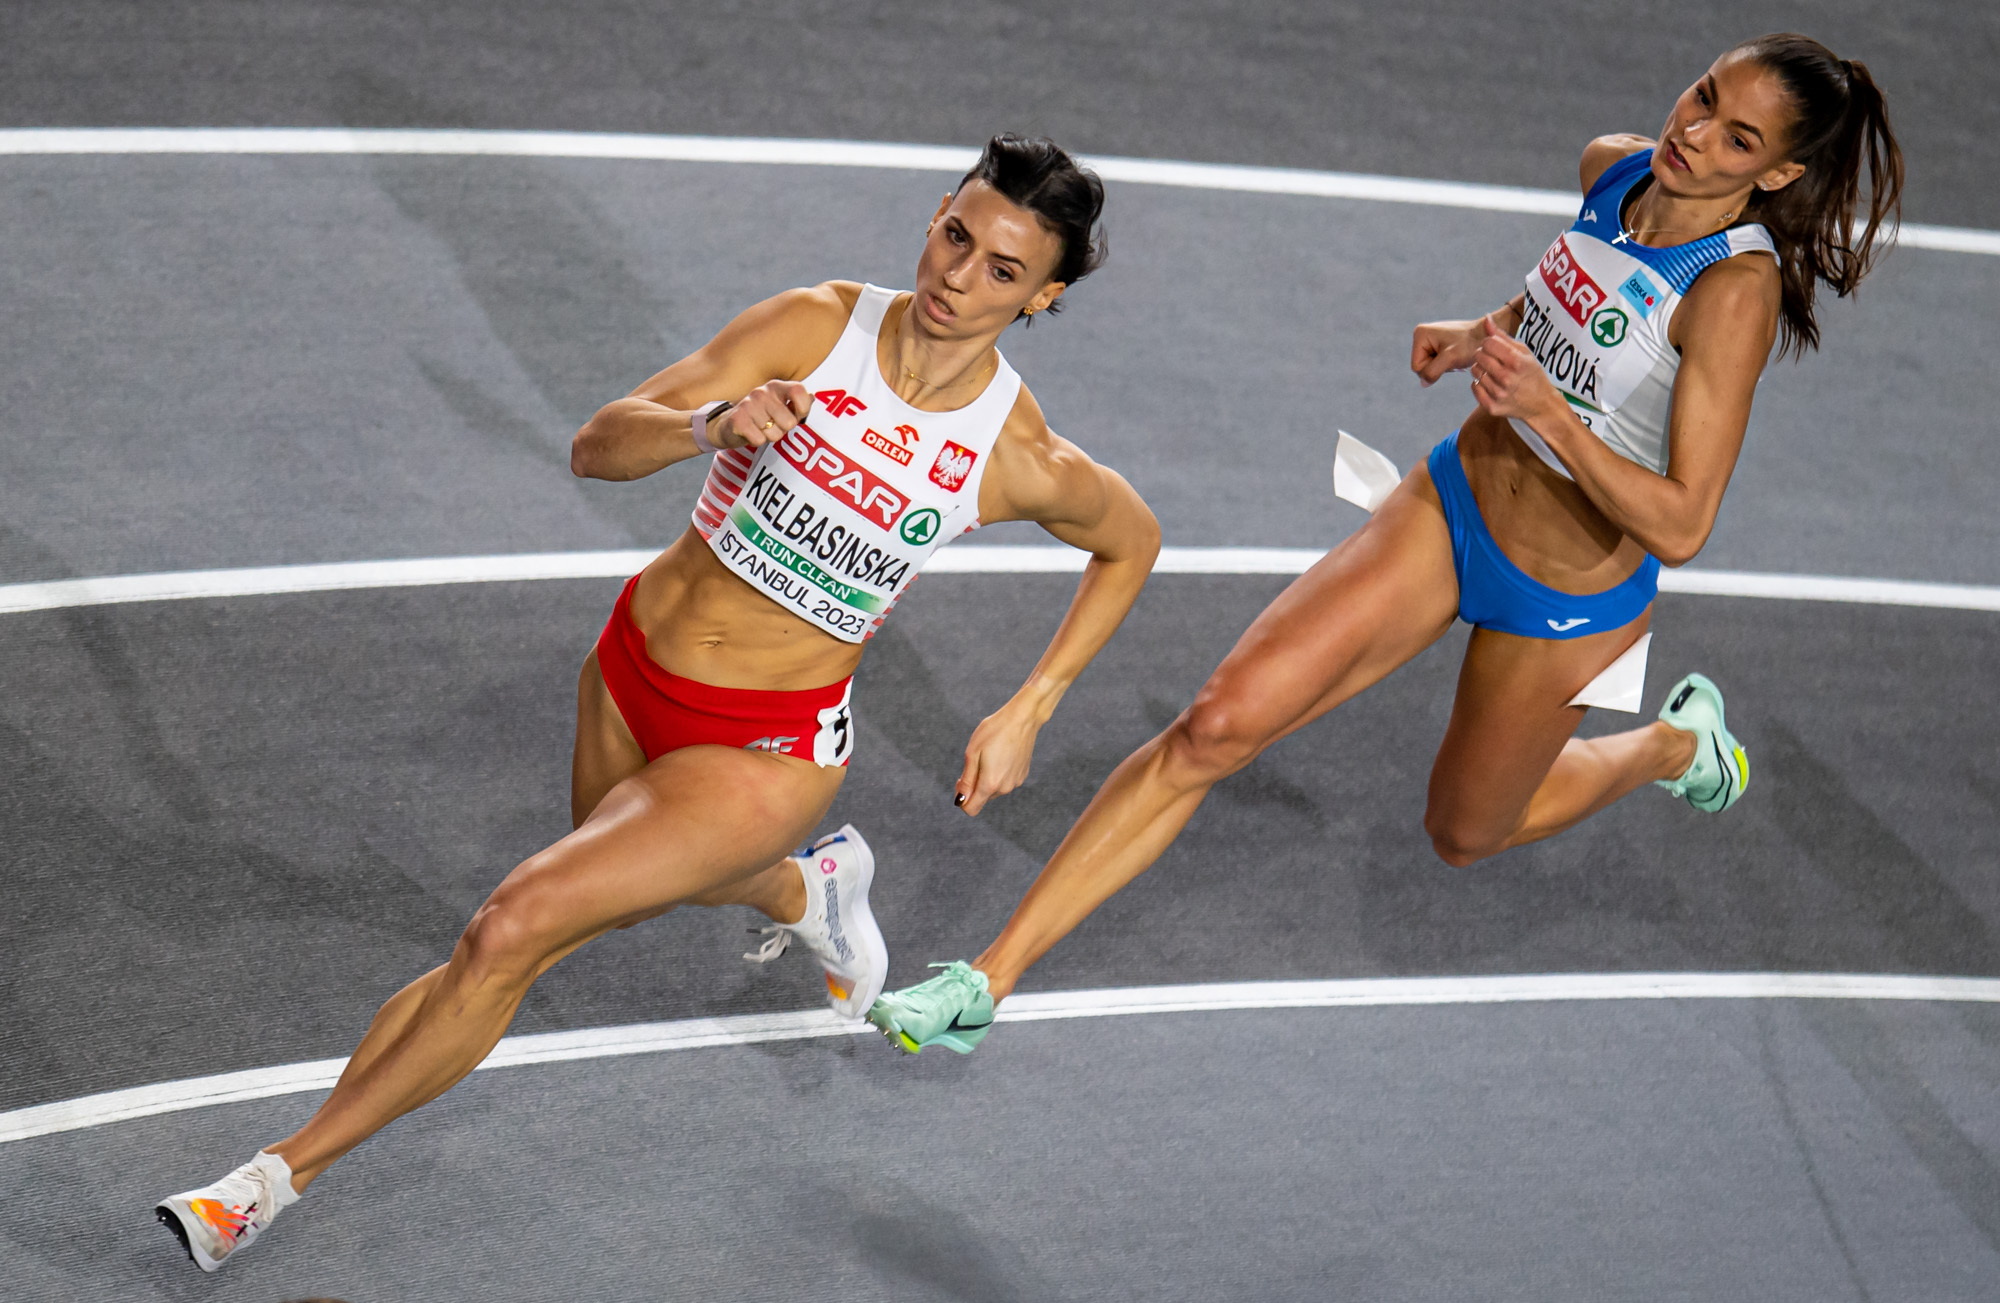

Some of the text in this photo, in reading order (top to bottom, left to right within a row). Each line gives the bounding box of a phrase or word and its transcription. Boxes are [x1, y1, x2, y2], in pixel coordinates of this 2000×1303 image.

[1542, 241, 1599, 320] SPAR
[779, 428, 902, 524] SPAR
[865, 432, 910, 463] ORLEN
[746, 465, 911, 592] KIELBASINSKA
[751, 529, 761, 541] I
[760, 537, 797, 566] RUN
[719, 530, 866, 635] ISTANBUL 2023
